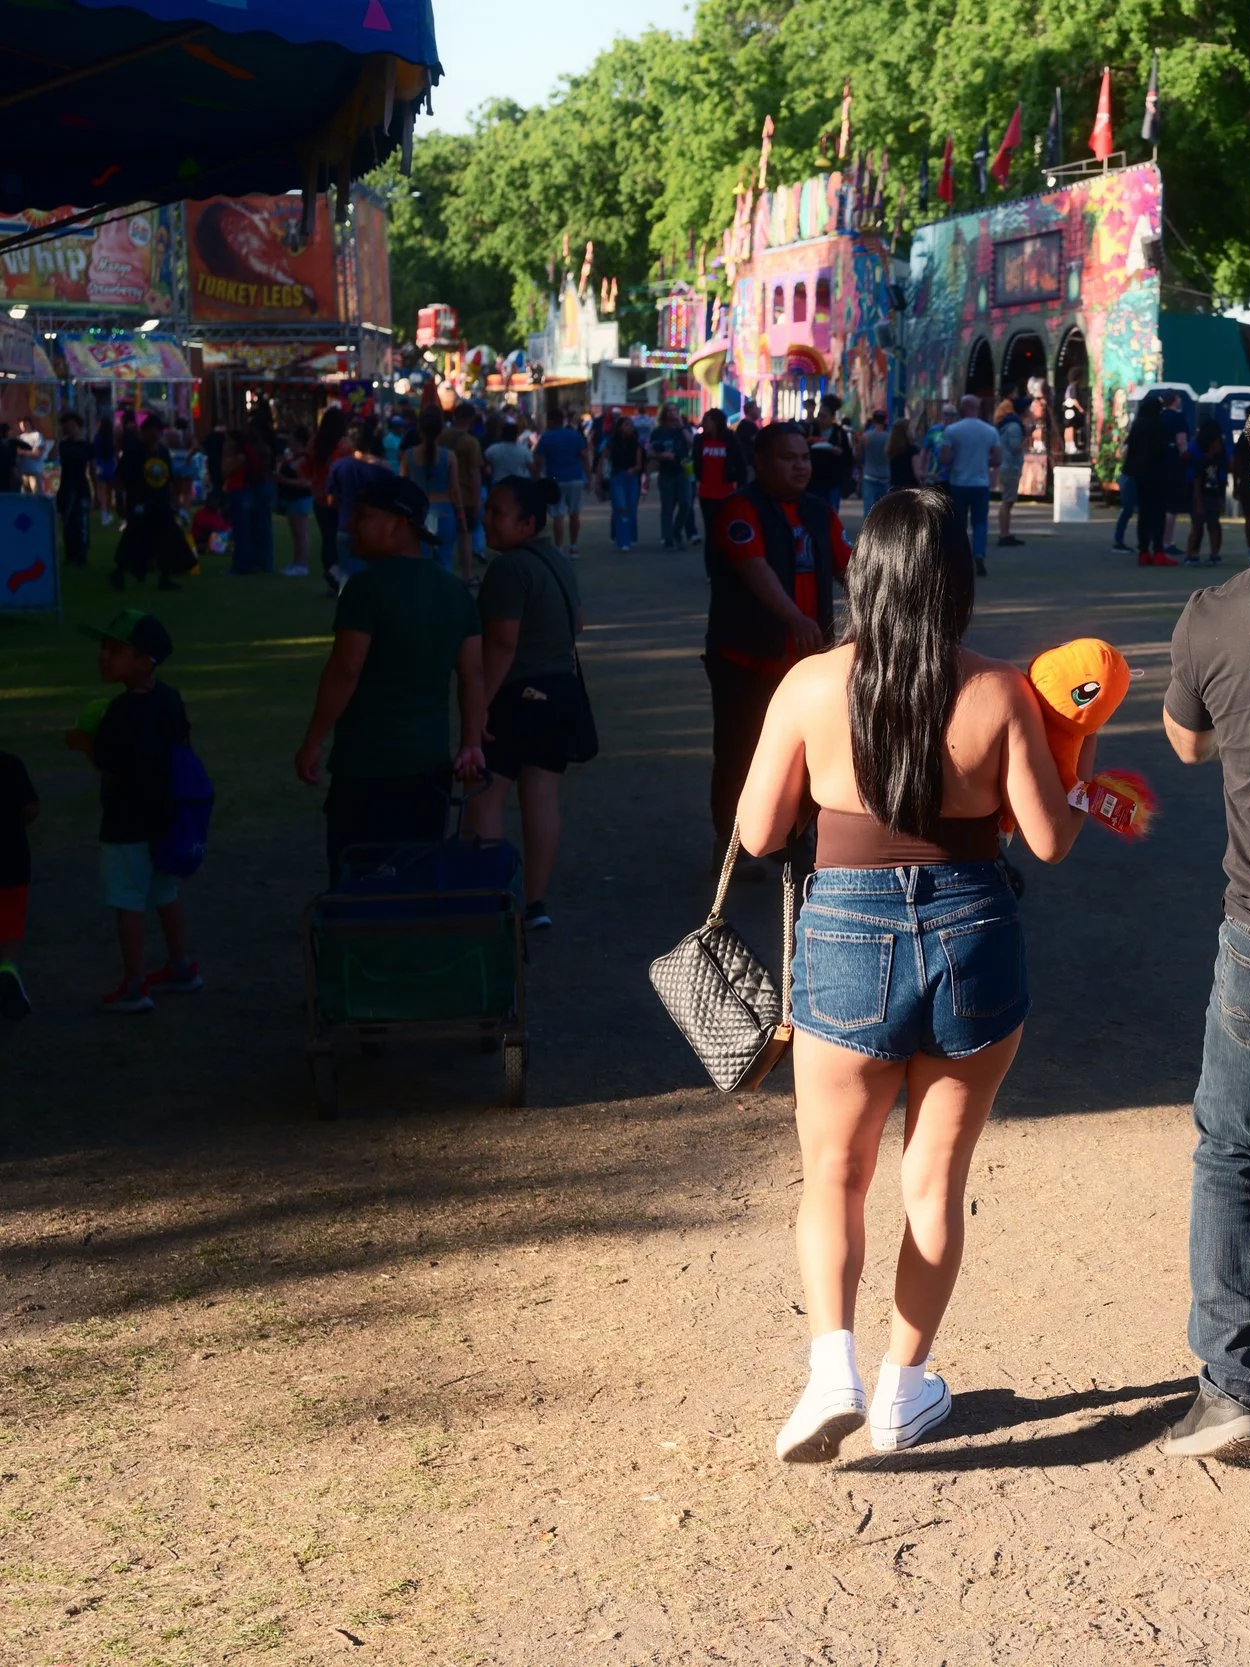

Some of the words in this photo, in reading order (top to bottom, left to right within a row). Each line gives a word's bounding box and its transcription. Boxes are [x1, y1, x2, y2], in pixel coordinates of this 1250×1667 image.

[3, 239, 86, 281] Whip
[197, 273, 257, 305] TURKEY
[263, 284, 303, 306] LEGS
[702, 446, 727, 457] PINK
